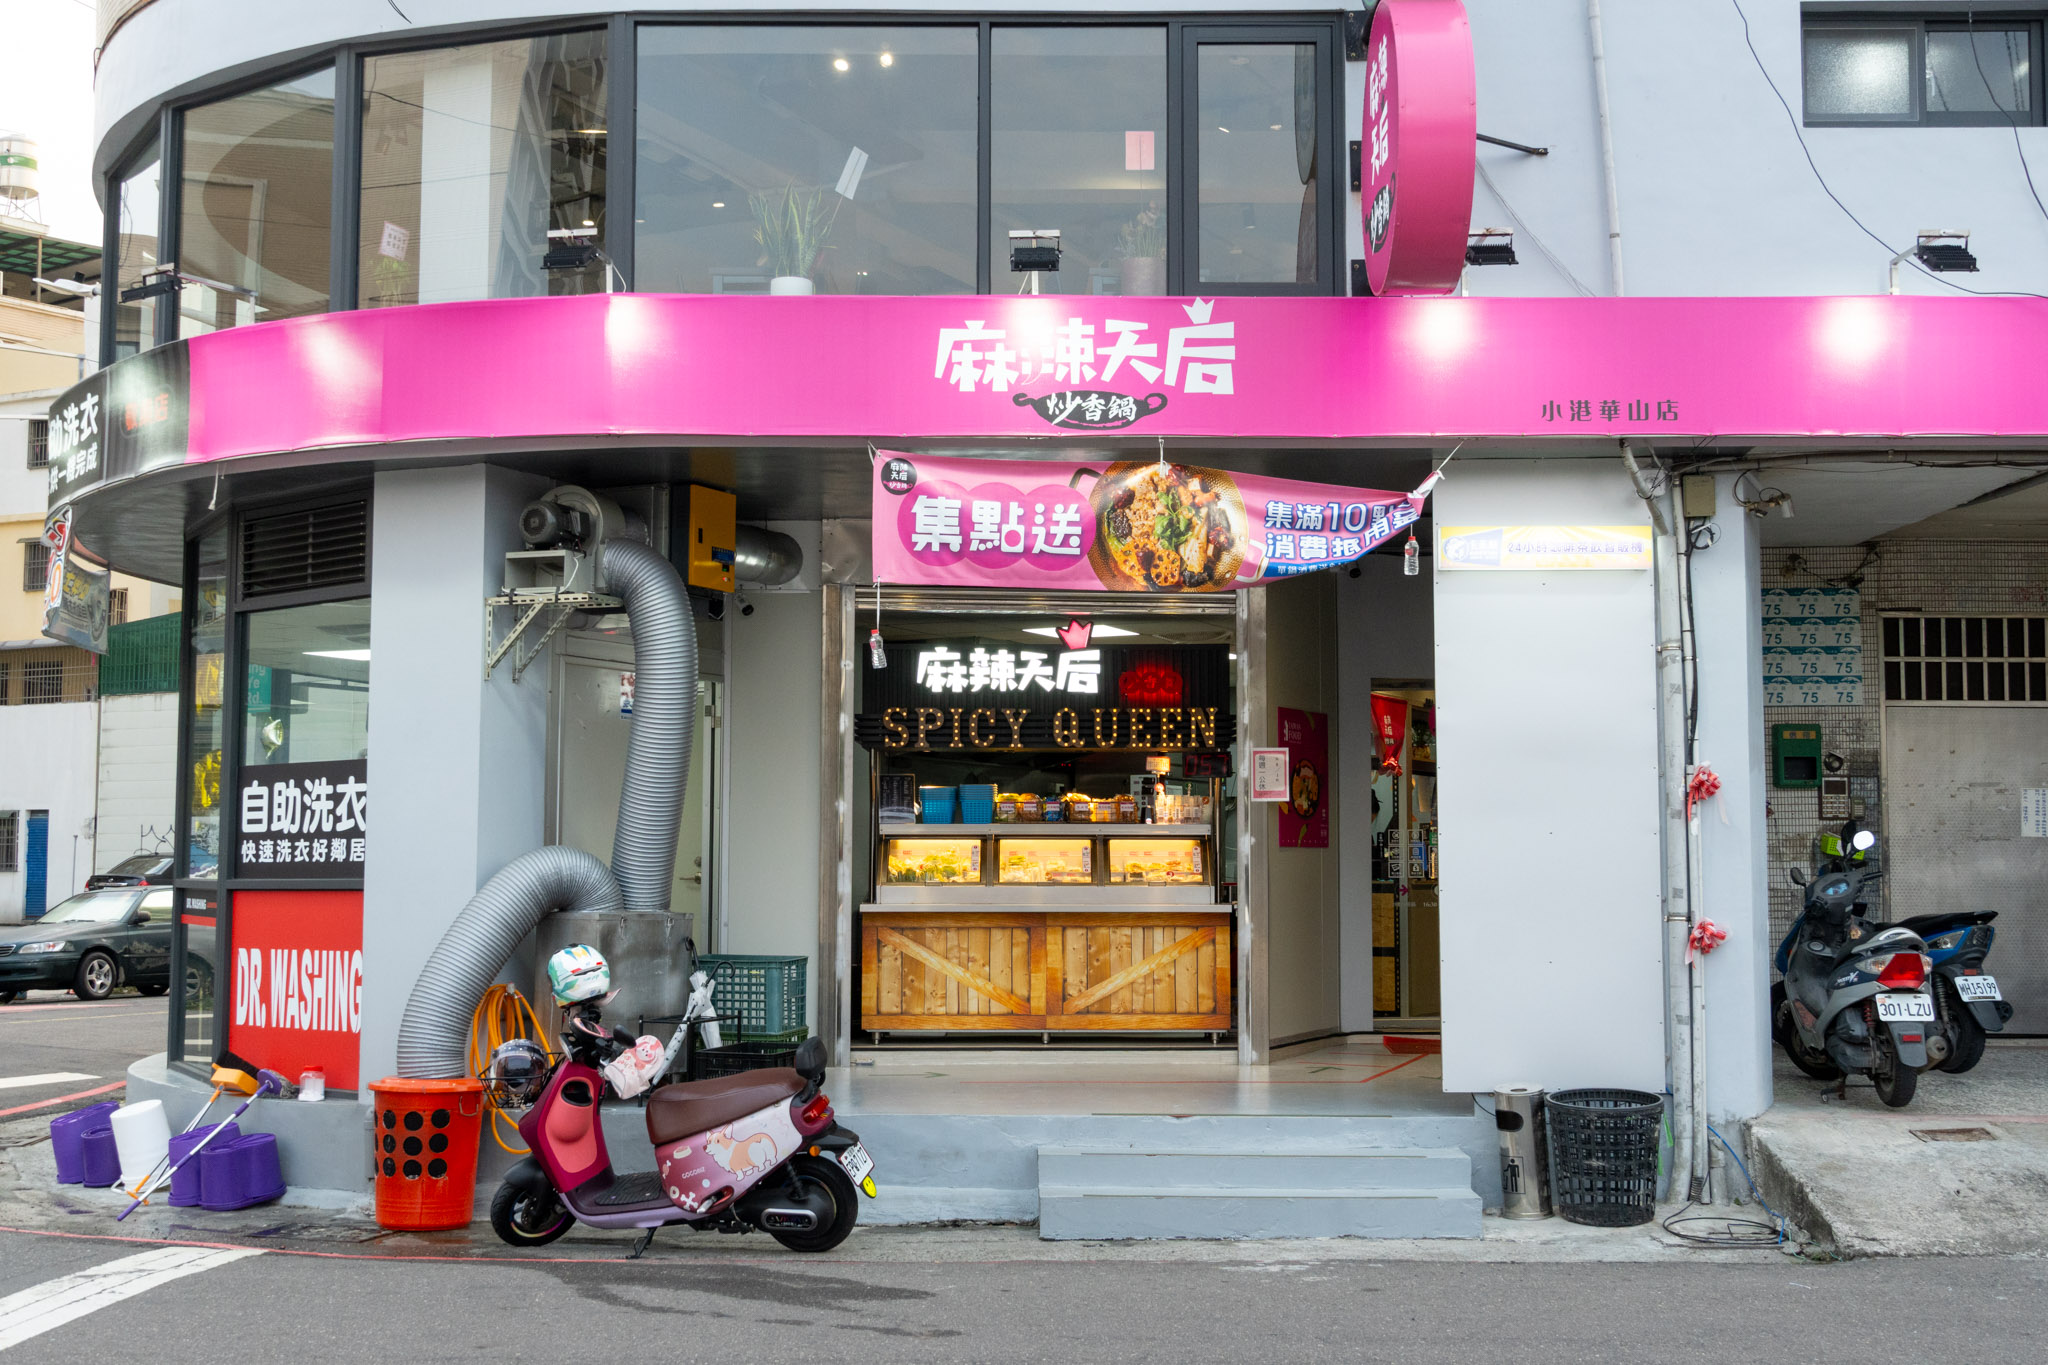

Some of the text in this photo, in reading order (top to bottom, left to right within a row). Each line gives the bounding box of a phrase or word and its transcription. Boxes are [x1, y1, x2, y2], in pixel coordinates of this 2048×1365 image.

[934, 317, 1236, 395] 麻辣天后
[1046, 390, 1138, 426] 炒香鍋
[1541, 399, 1680, 422] 小港華山店
[890, 471, 908, 481] 天后
[911, 495, 1082, 555] 集點送
[1765, 604, 1781, 615] 75
[1799, 604, 1816, 615] 75
[1834, 604, 1851, 614] 75
[1766, 634, 1782, 644] 75
[1800, 634, 1817, 644] 75
[1835, 633, 1852, 644] 75
[916, 646, 1101, 693] 麻辣天后
[1766, 663, 1783, 673] 75
[1801, 663, 1818, 673] 75
[1836, 662, 1853, 673] 75
[1767, 692, 1784, 703] 75
[1802, 692, 1818, 703] 75
[1837, 692, 1854, 702] 75
[882, 706, 1220, 748] SPICY QUEEN
[241, 775, 368, 834] 自助洗衣
[241, 838, 365, 863] 快速洗衣好鄰居
[236, 947, 364, 1034] DR. WASHING
